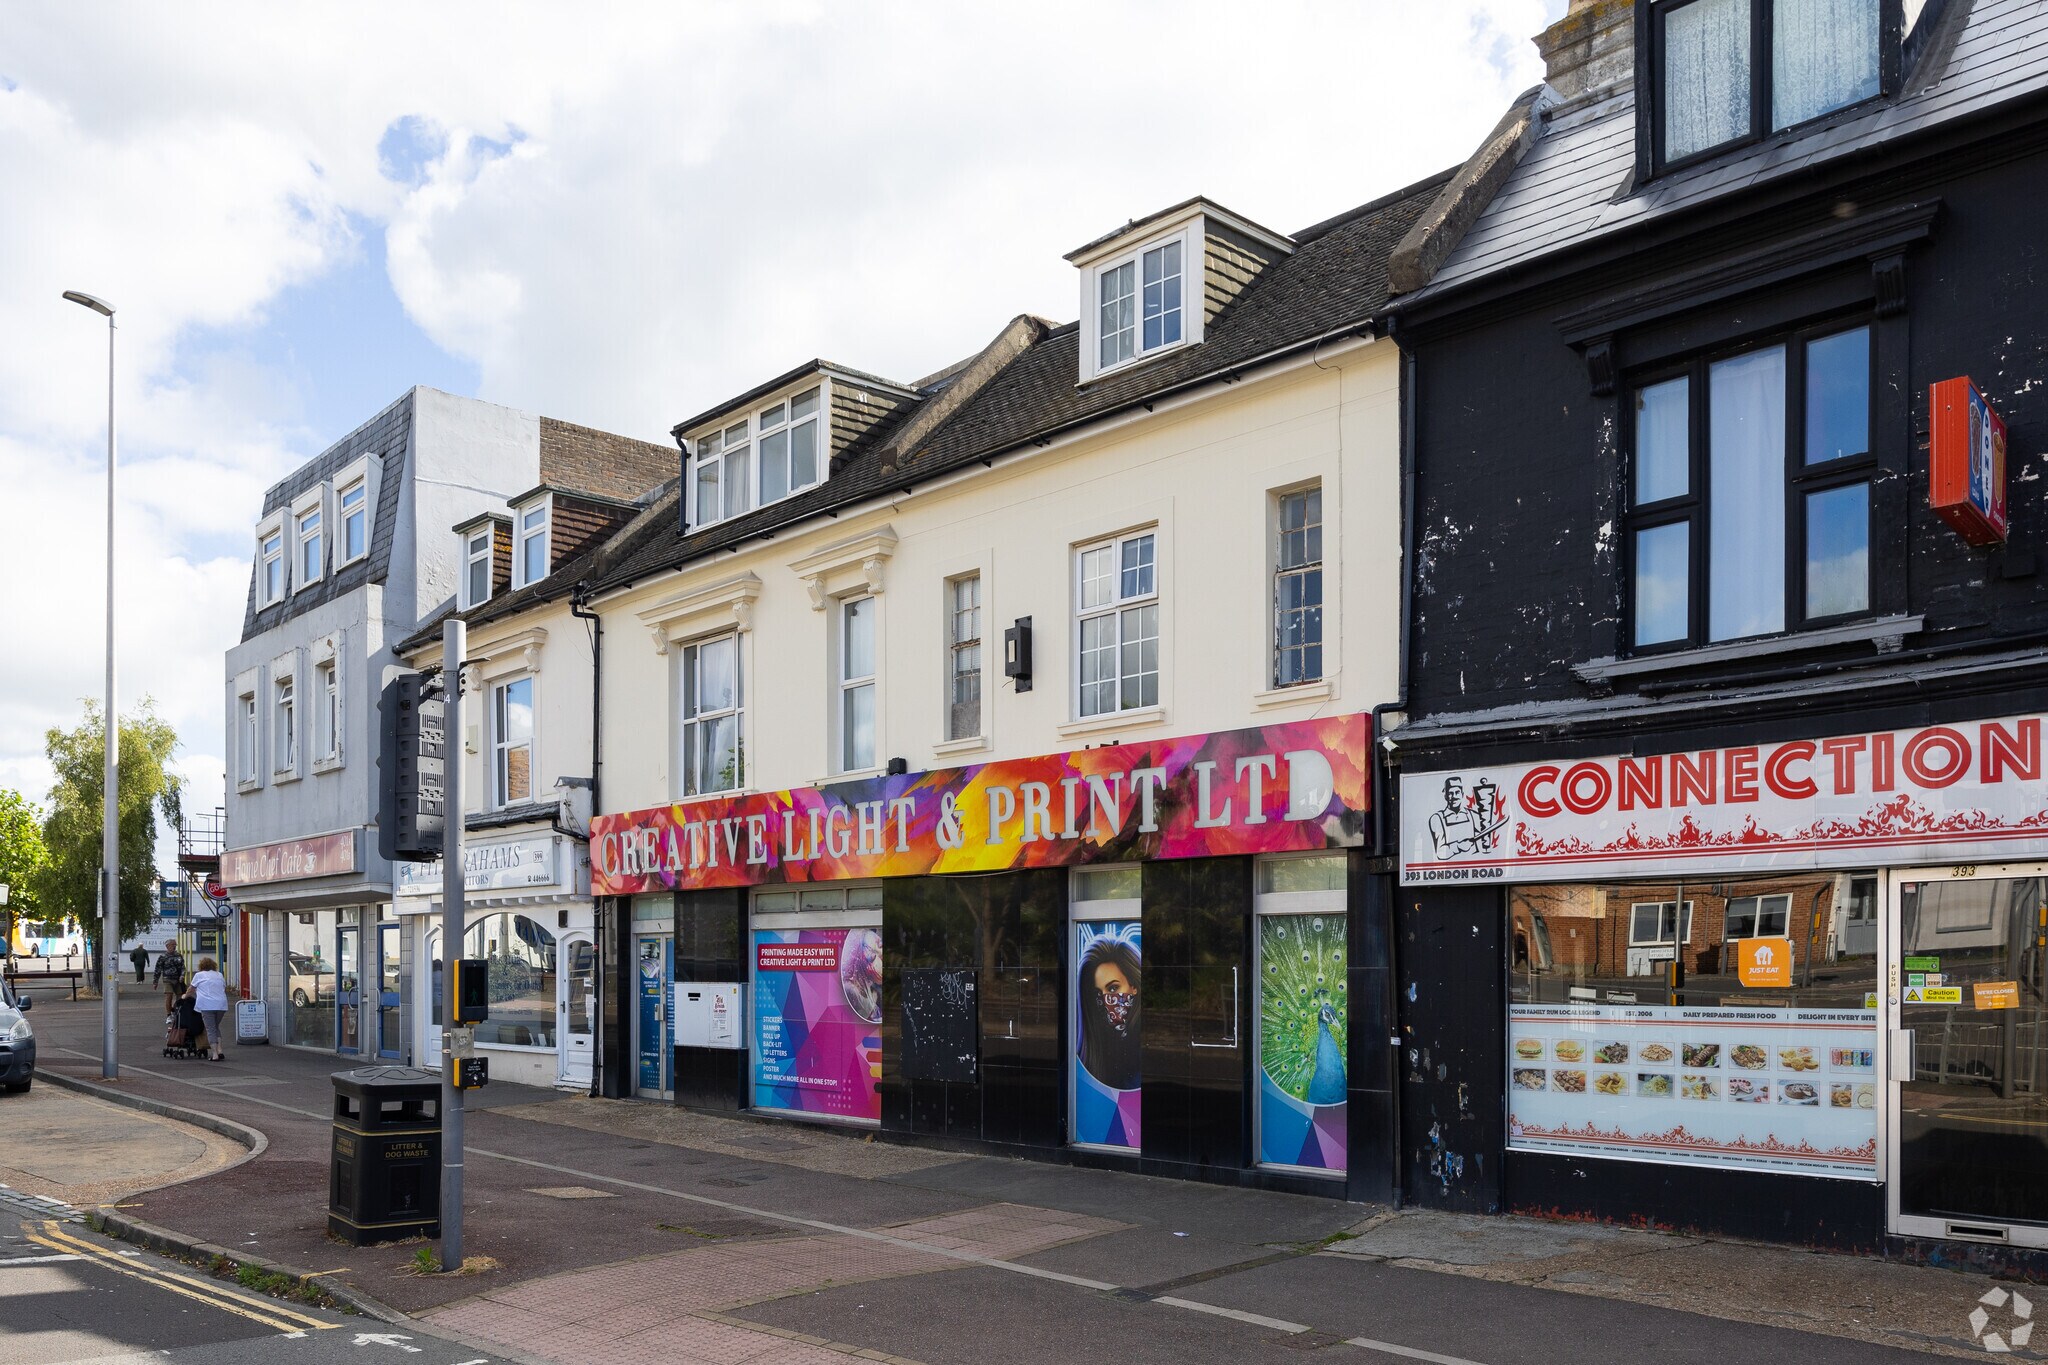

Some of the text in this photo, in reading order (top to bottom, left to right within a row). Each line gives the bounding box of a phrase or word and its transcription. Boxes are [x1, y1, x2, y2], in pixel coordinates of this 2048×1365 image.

[1517, 718, 2041, 817] CONNECTION
[601, 749, 1335, 878] CREATIVE LIGHT & PRINT LTD
[534, 852, 543, 860] 399
[234, 844, 303, 881] Home Chef Café
[1405, 868, 1504, 881] 393 LONDON ROAD
[1952, 866, 1976, 877] 393
[761, 948, 834, 956] PRINTING MADE EASY WITH
[760, 958, 784, 966] CREATIVE
[807, 958, 824, 966] PRINT
[824, 958, 836, 966] LTD
